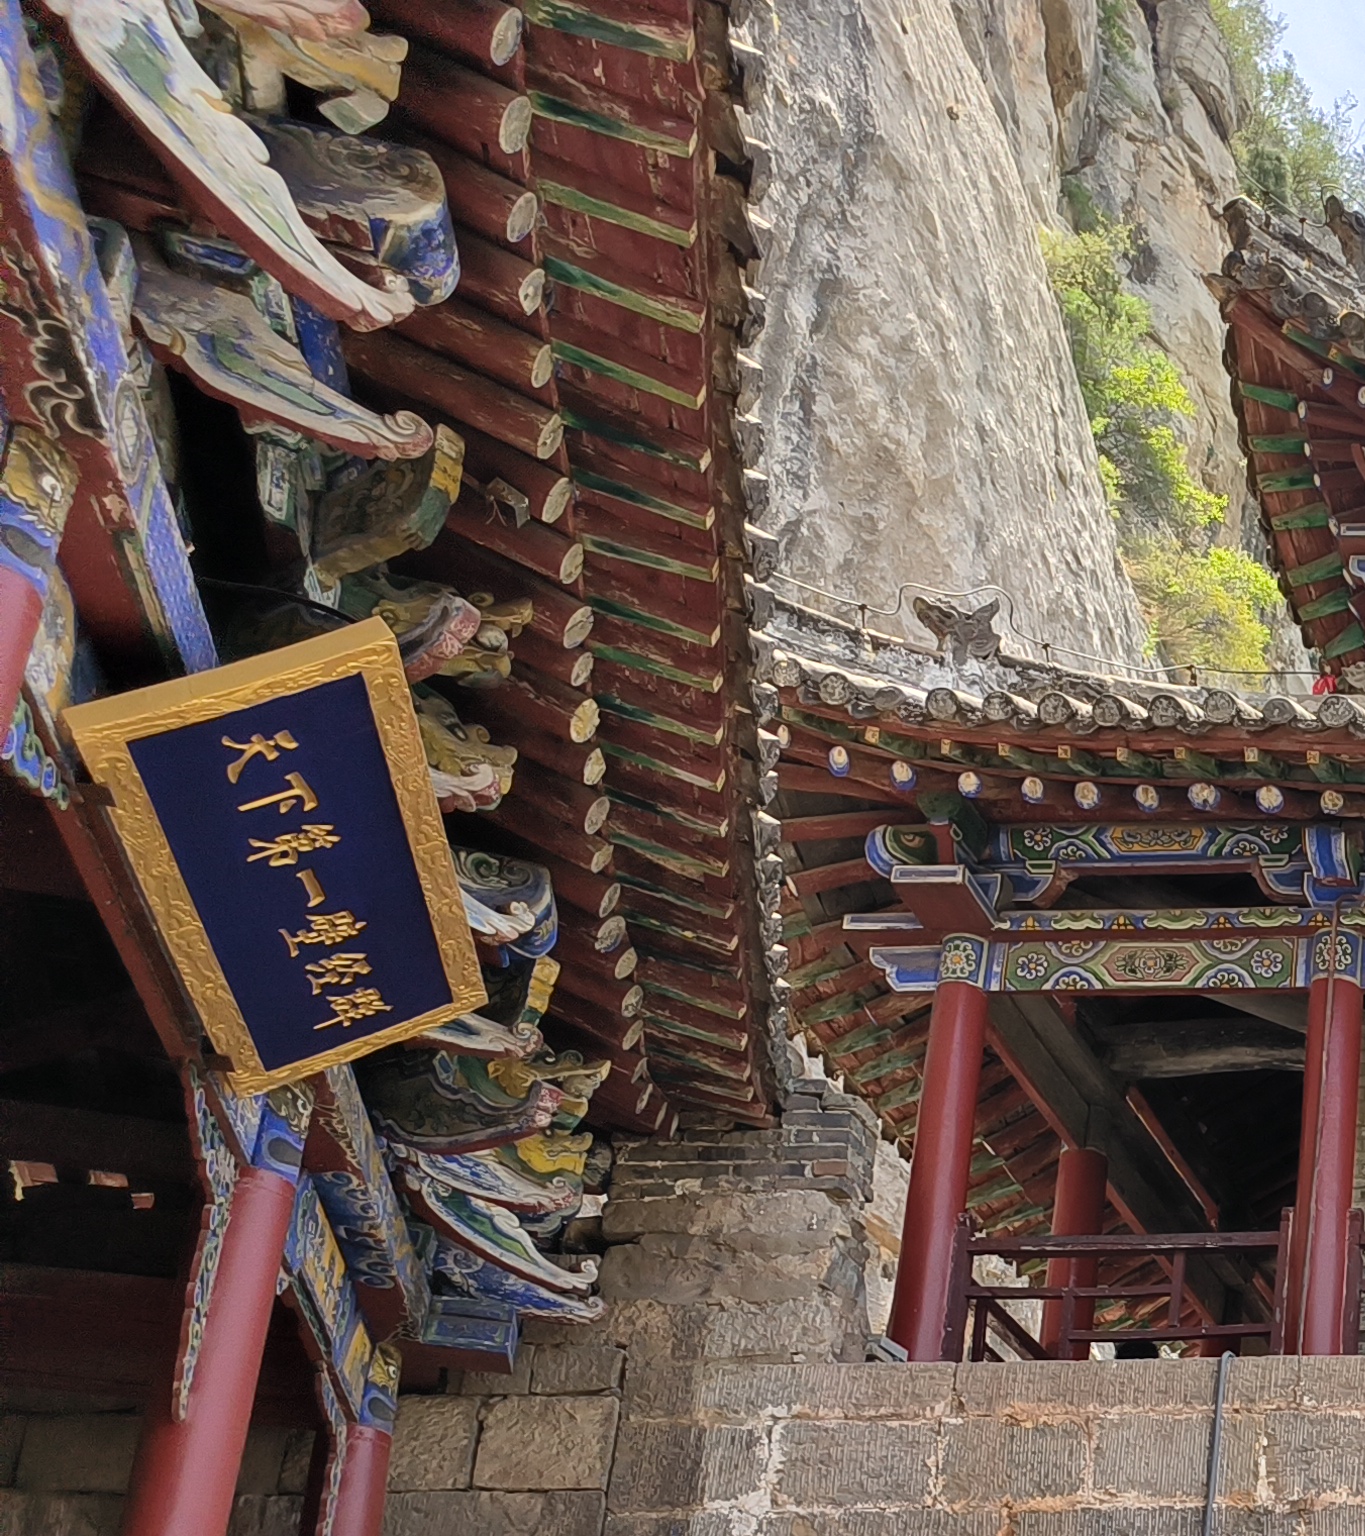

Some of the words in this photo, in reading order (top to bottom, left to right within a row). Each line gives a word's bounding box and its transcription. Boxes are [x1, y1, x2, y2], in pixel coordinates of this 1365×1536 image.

[221, 728, 394, 1030] 天下第一壁经群
